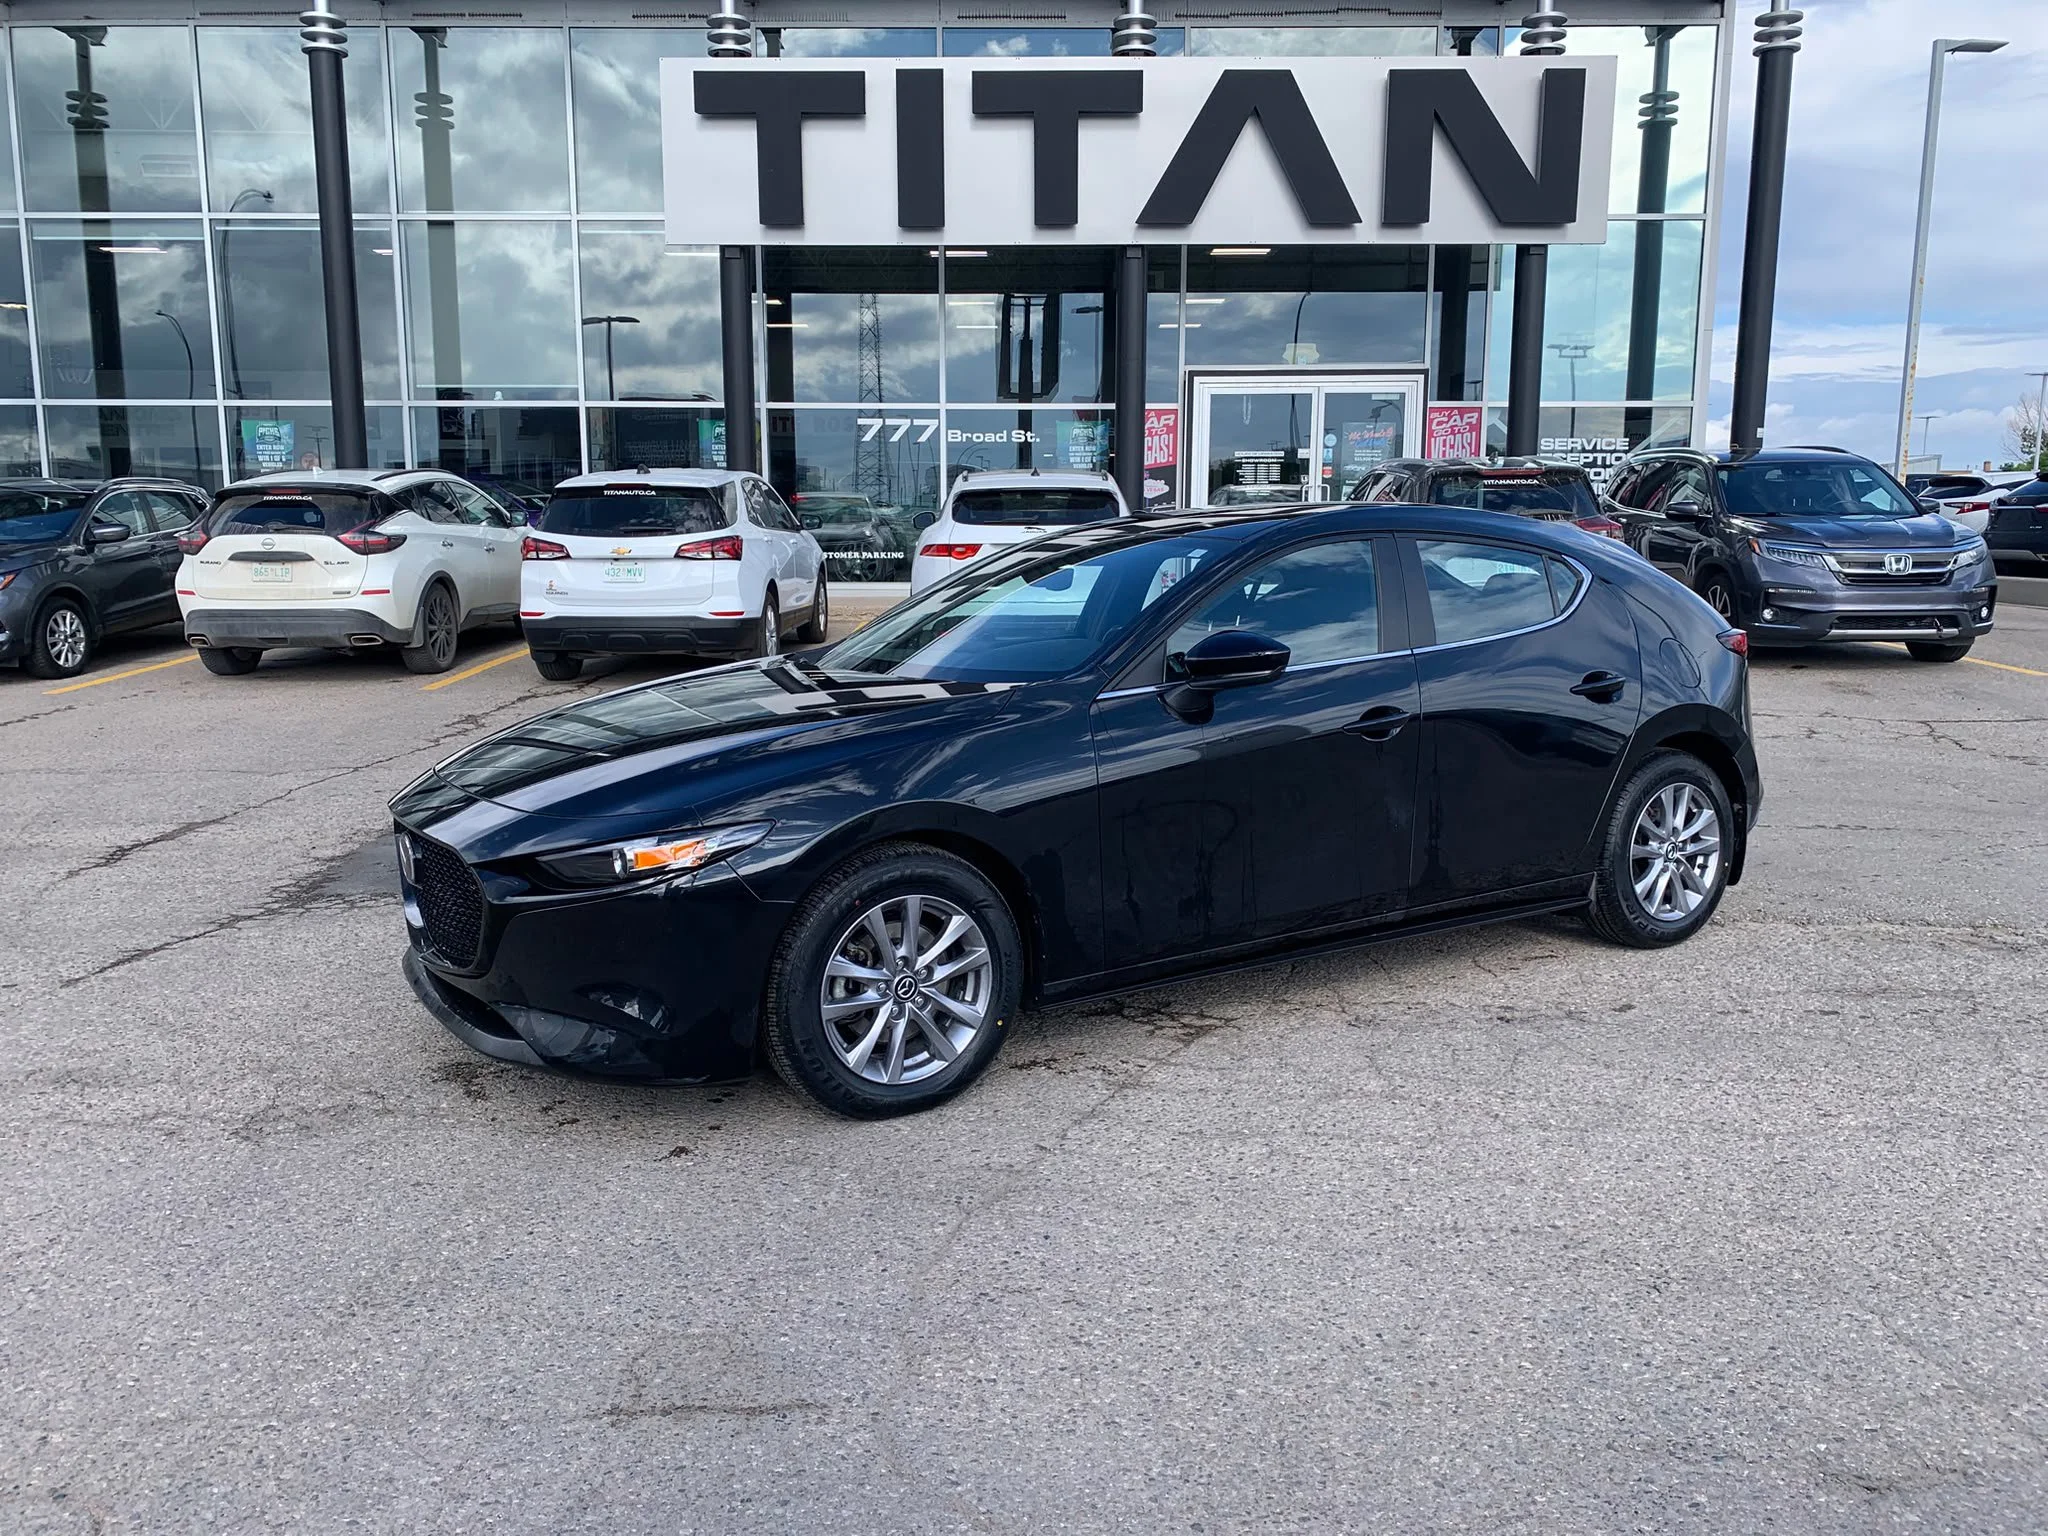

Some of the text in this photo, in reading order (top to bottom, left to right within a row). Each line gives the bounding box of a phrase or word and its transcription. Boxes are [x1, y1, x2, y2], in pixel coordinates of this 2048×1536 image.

[694, 69, 1587, 229] TITAN
[1145, 414, 1175, 429] AR
[1431, 412, 1479, 430] CAR
[857, 418, 939, 442] 777
[947, 430, 1007, 443] Broad
[1011, 430, 1041, 443] St.
[1433, 428, 1451, 437] GO
[1144, 433, 1173, 466] GAS!
[1431, 431, 1476, 460] VEGAS!
[1540, 437, 1630, 450] SERVICE
[1483, 478, 1540, 486] TITANAUTO.CA
[603, 489, 657, 497] TITANAUTO.CA
[822, 550, 905, 560] STOMER PARKING
[604, 567, 621, 577] 432
